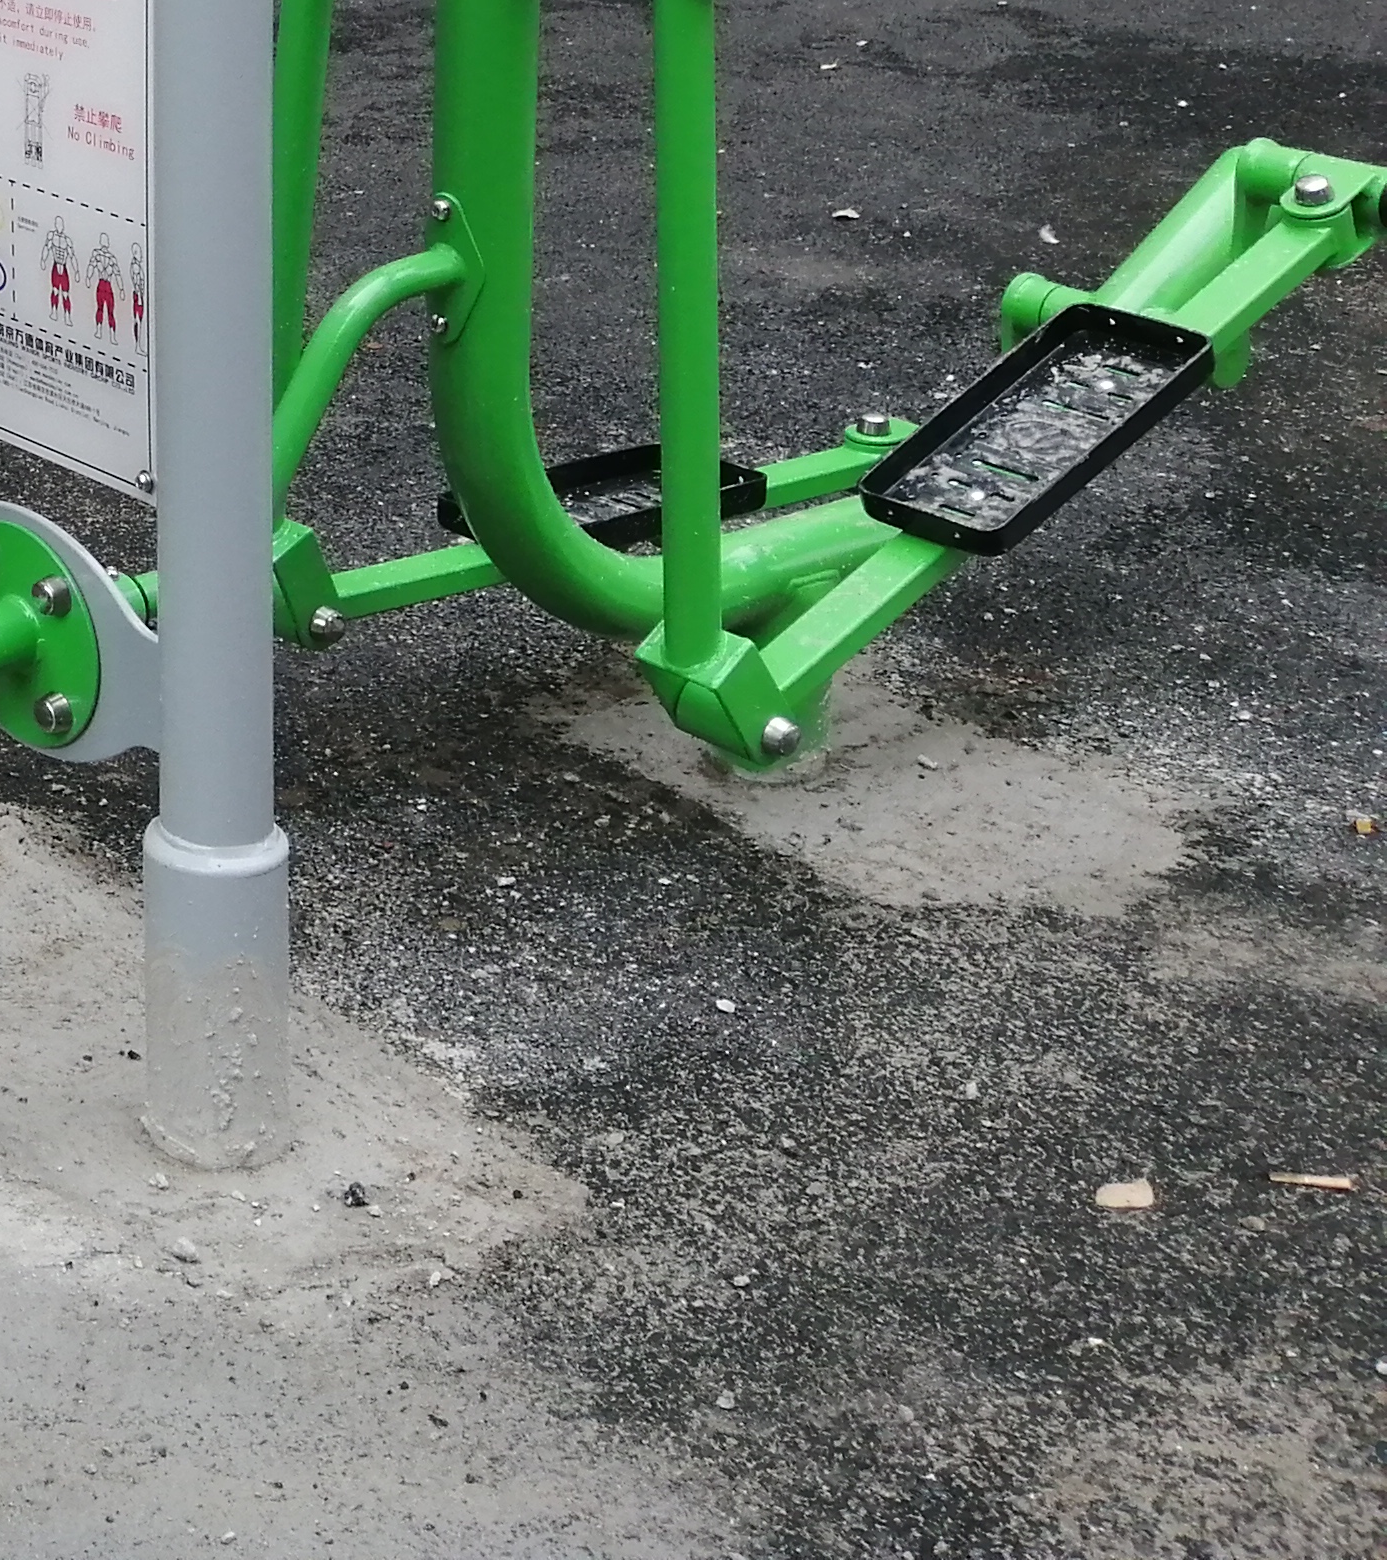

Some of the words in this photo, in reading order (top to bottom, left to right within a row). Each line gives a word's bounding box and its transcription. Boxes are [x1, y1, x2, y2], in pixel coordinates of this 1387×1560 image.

[0, 32, 8, 44] it
[13, 36, 63, 61] immediately
[39, 25, 68, 45] during
[73, 103, 123, 133] 禁止攀爬
[67, 125, 80, 141] No
[85, 131, 135, 161] Climbing
